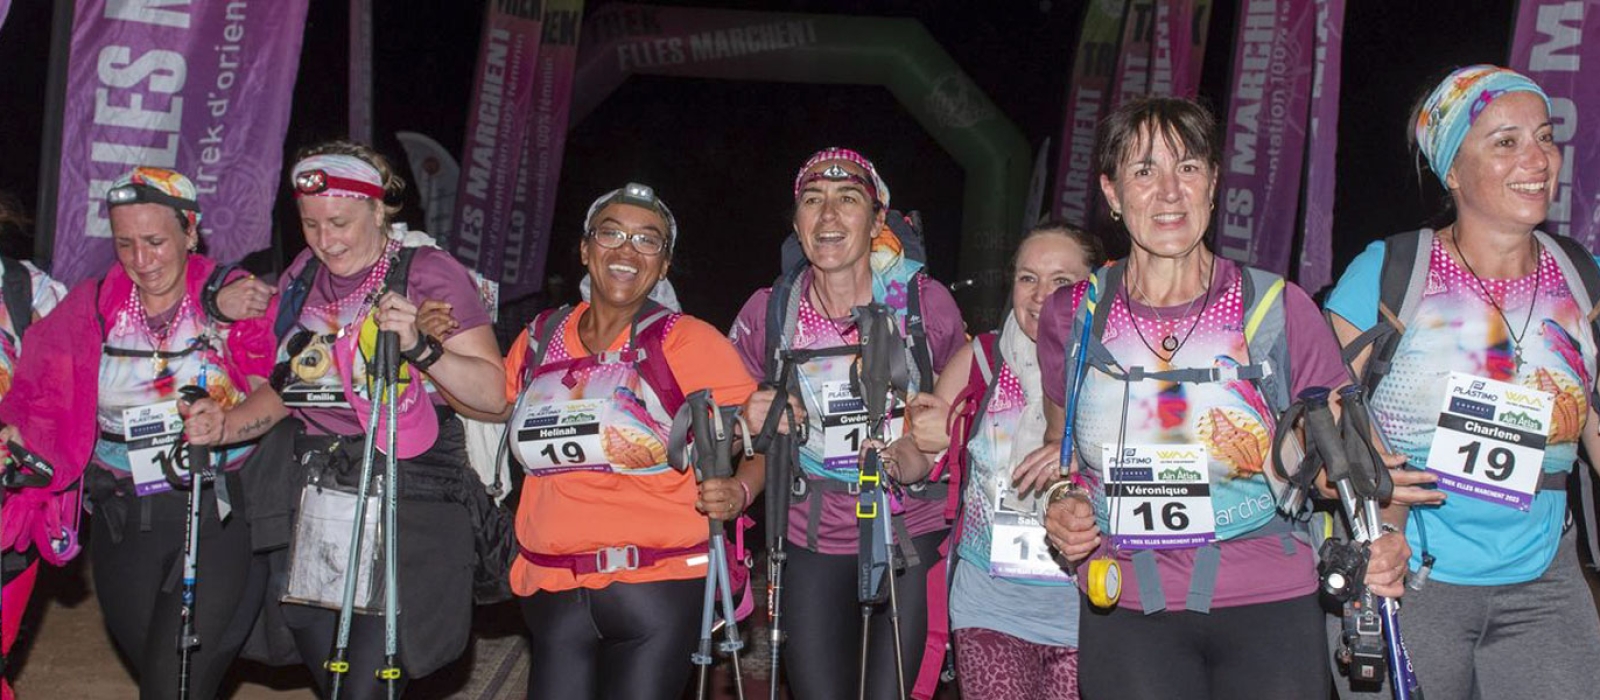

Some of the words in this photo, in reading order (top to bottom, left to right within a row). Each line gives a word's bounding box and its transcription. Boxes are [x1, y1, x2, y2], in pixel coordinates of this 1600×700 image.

[616, 36, 687, 71] ELLES
[689, 18, 819, 63] MARCHENT
[466, 28, 510, 201] MARCHENT
[84, 46, 187, 239] LES
[306, 392, 336, 401] Emilie
[1453, 386, 1498, 402] PLASTIMO
[540, 427, 577, 438] Helinah
[1464, 421, 1522, 442] Charlene
[540, 441, 587, 465] 19
[1108, 457, 1152, 465] PLASTIMO
[1457, 440, 1516, 482] 19
[1126, 485, 1188, 496] Véronique
[1133, 501, 1190, 531] 16
